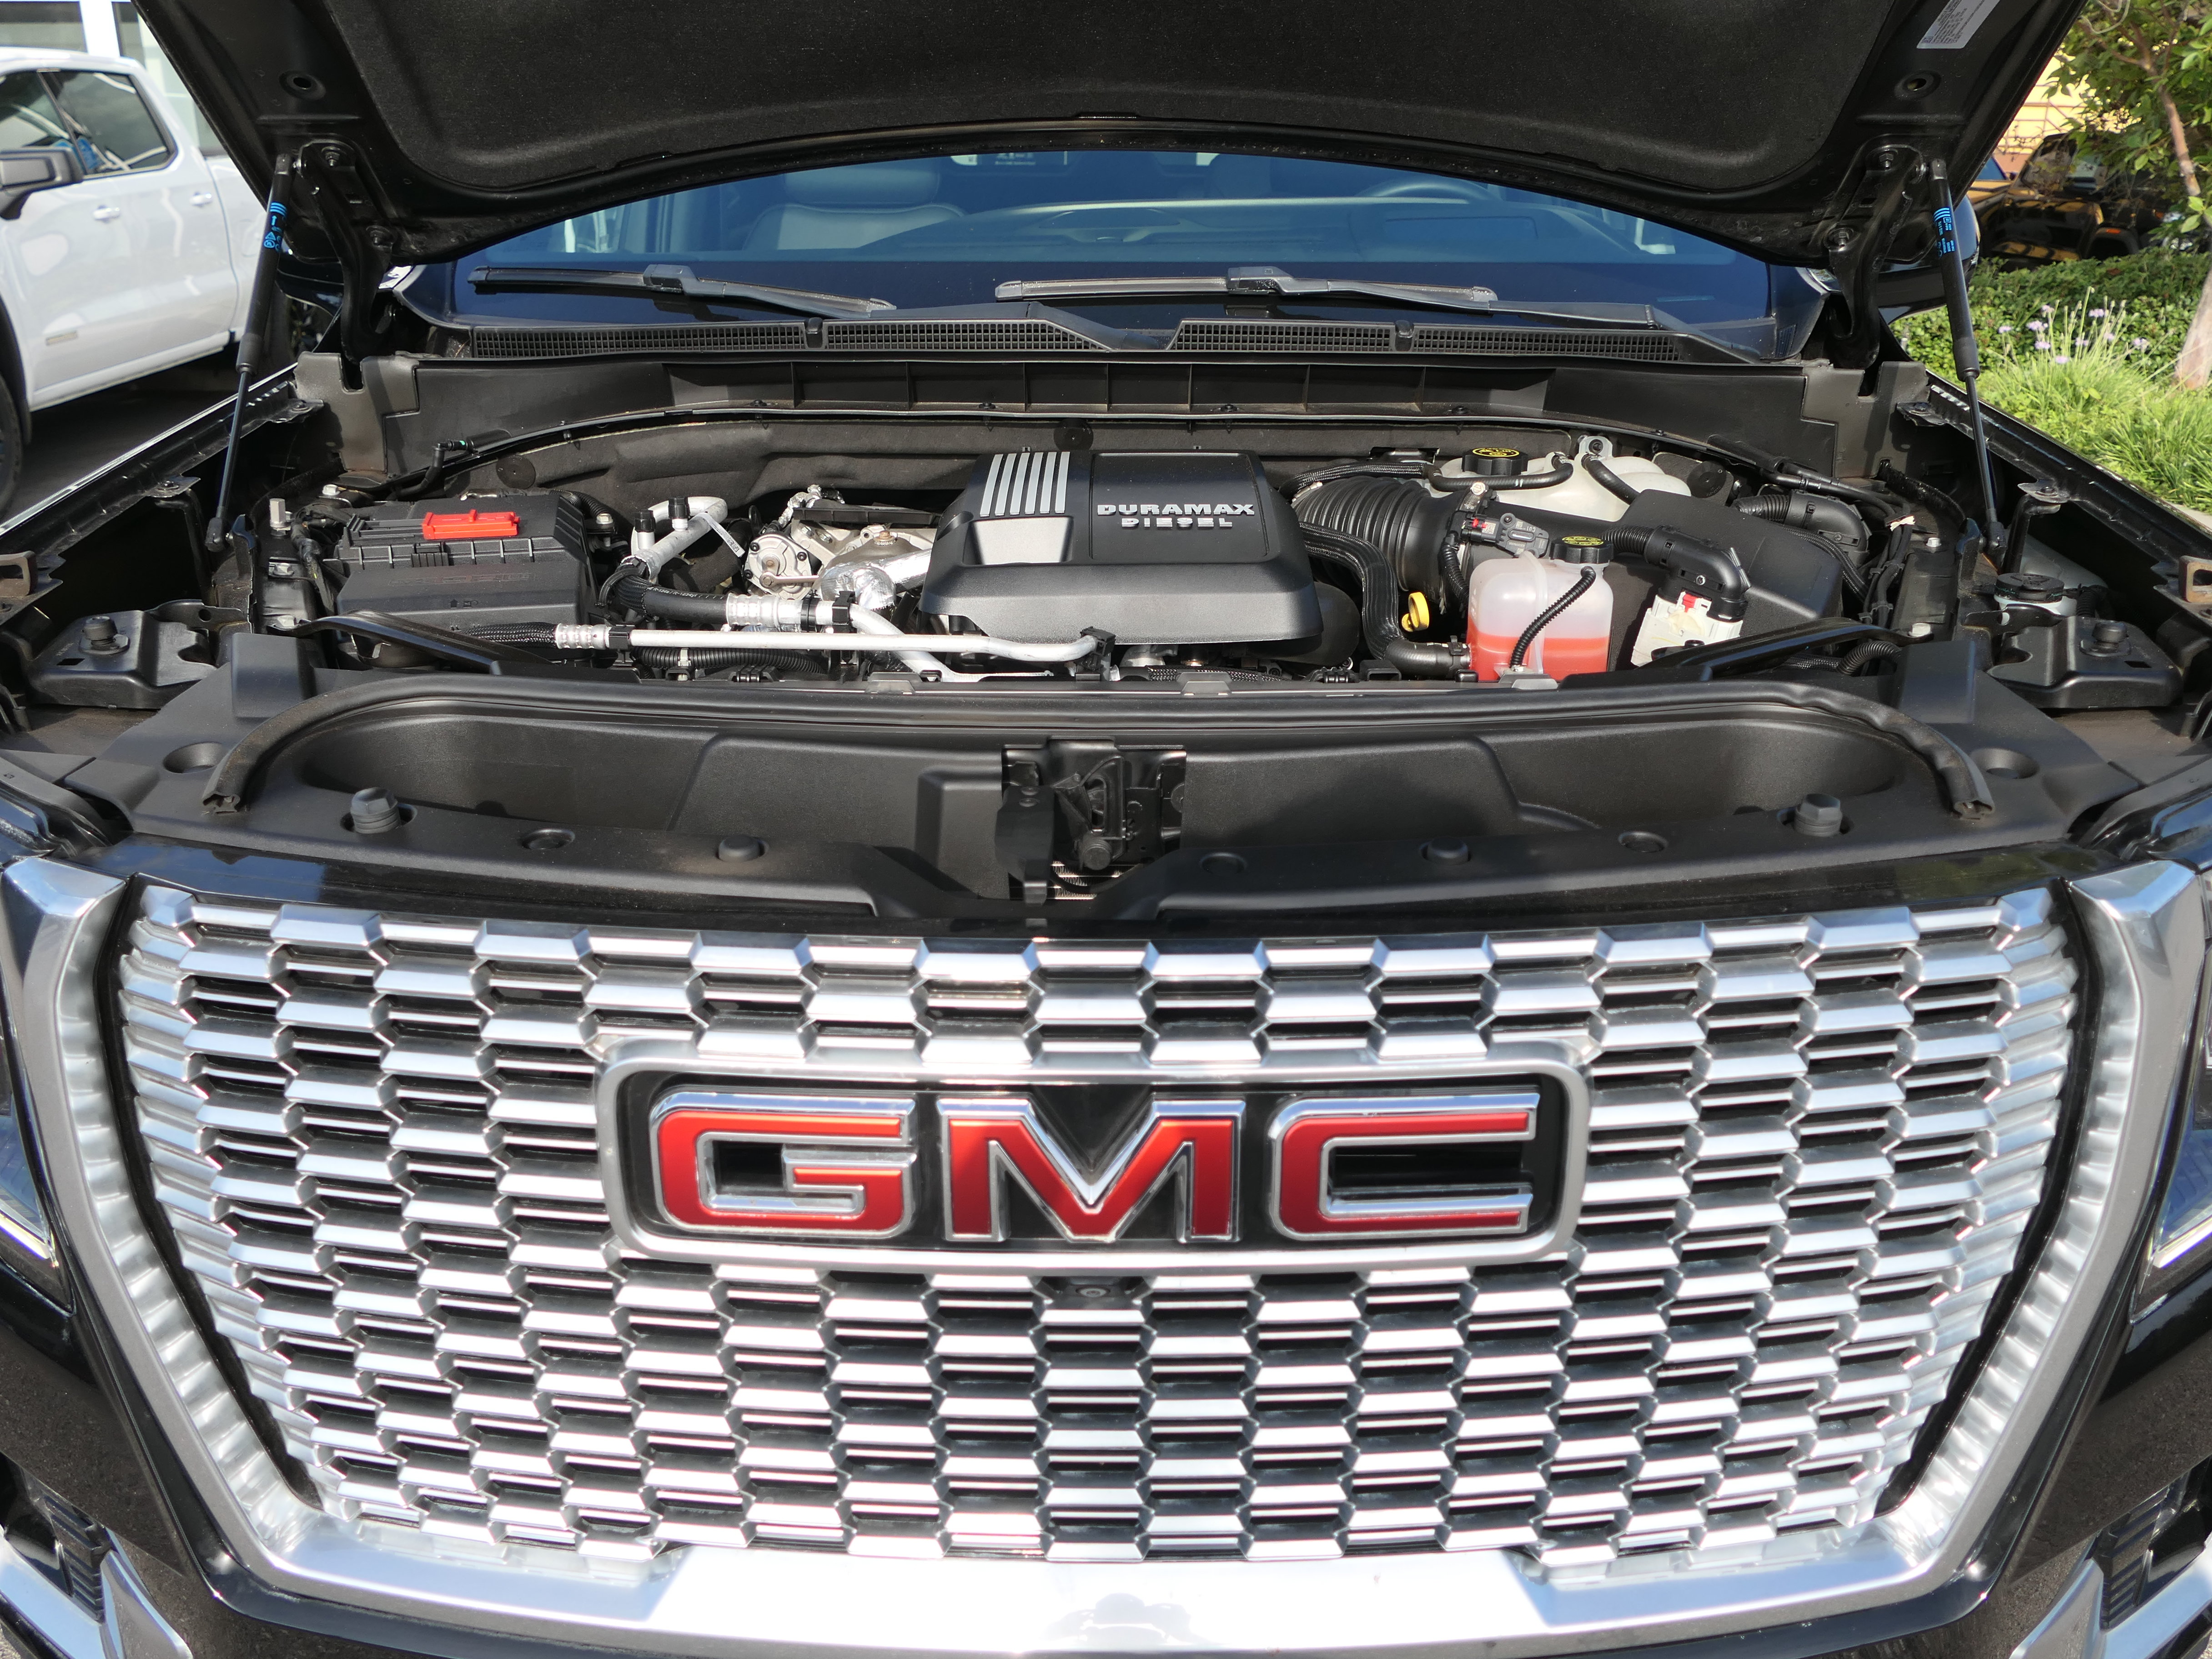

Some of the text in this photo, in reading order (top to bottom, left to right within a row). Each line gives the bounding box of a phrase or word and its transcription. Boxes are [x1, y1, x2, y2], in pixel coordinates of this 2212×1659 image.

[1097, 504, 1255, 515] DURAMAX
[1121, 518, 1233, 527] DIESEL
[650, 1091, 1540, 1242] GMC
